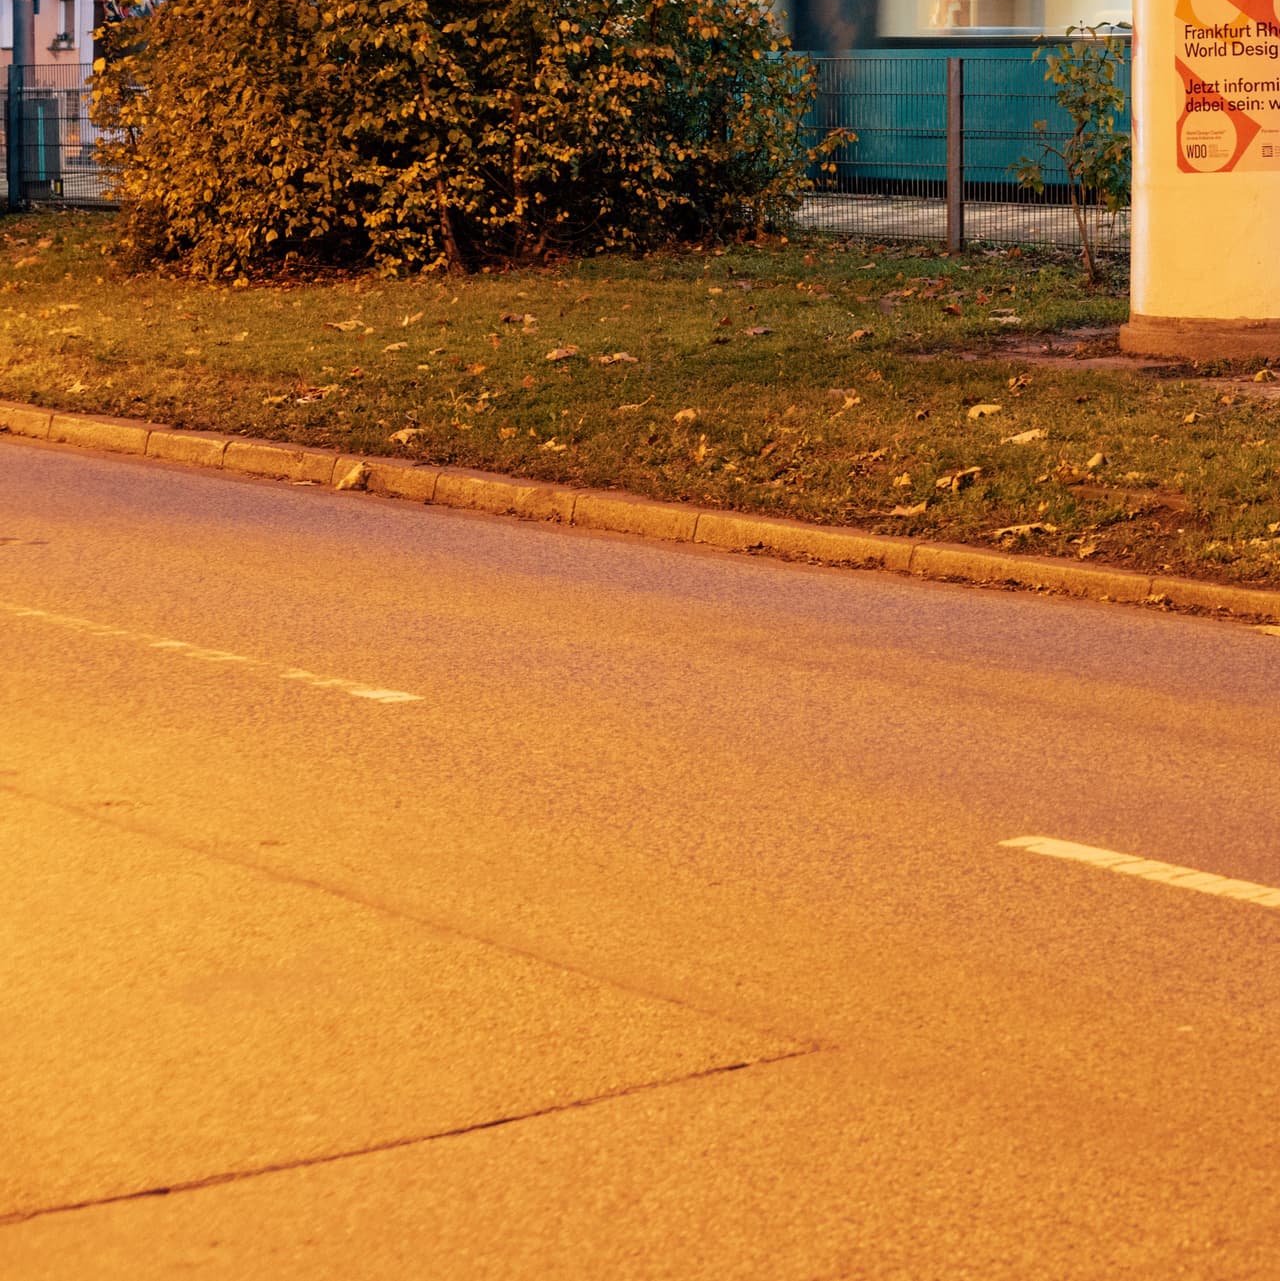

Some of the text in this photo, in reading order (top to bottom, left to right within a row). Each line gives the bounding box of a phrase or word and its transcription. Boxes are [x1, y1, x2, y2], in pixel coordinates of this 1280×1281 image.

[1184, 23, 1252, 40] Frankfurt
[1184, 41, 1227, 58] World
[1185, 78, 1220, 95] Jetzt
[1185, 96, 1224, 113] dabei
[1228, 96, 1265, 111] sein:
[1186, 144, 1207, 159] WDO
